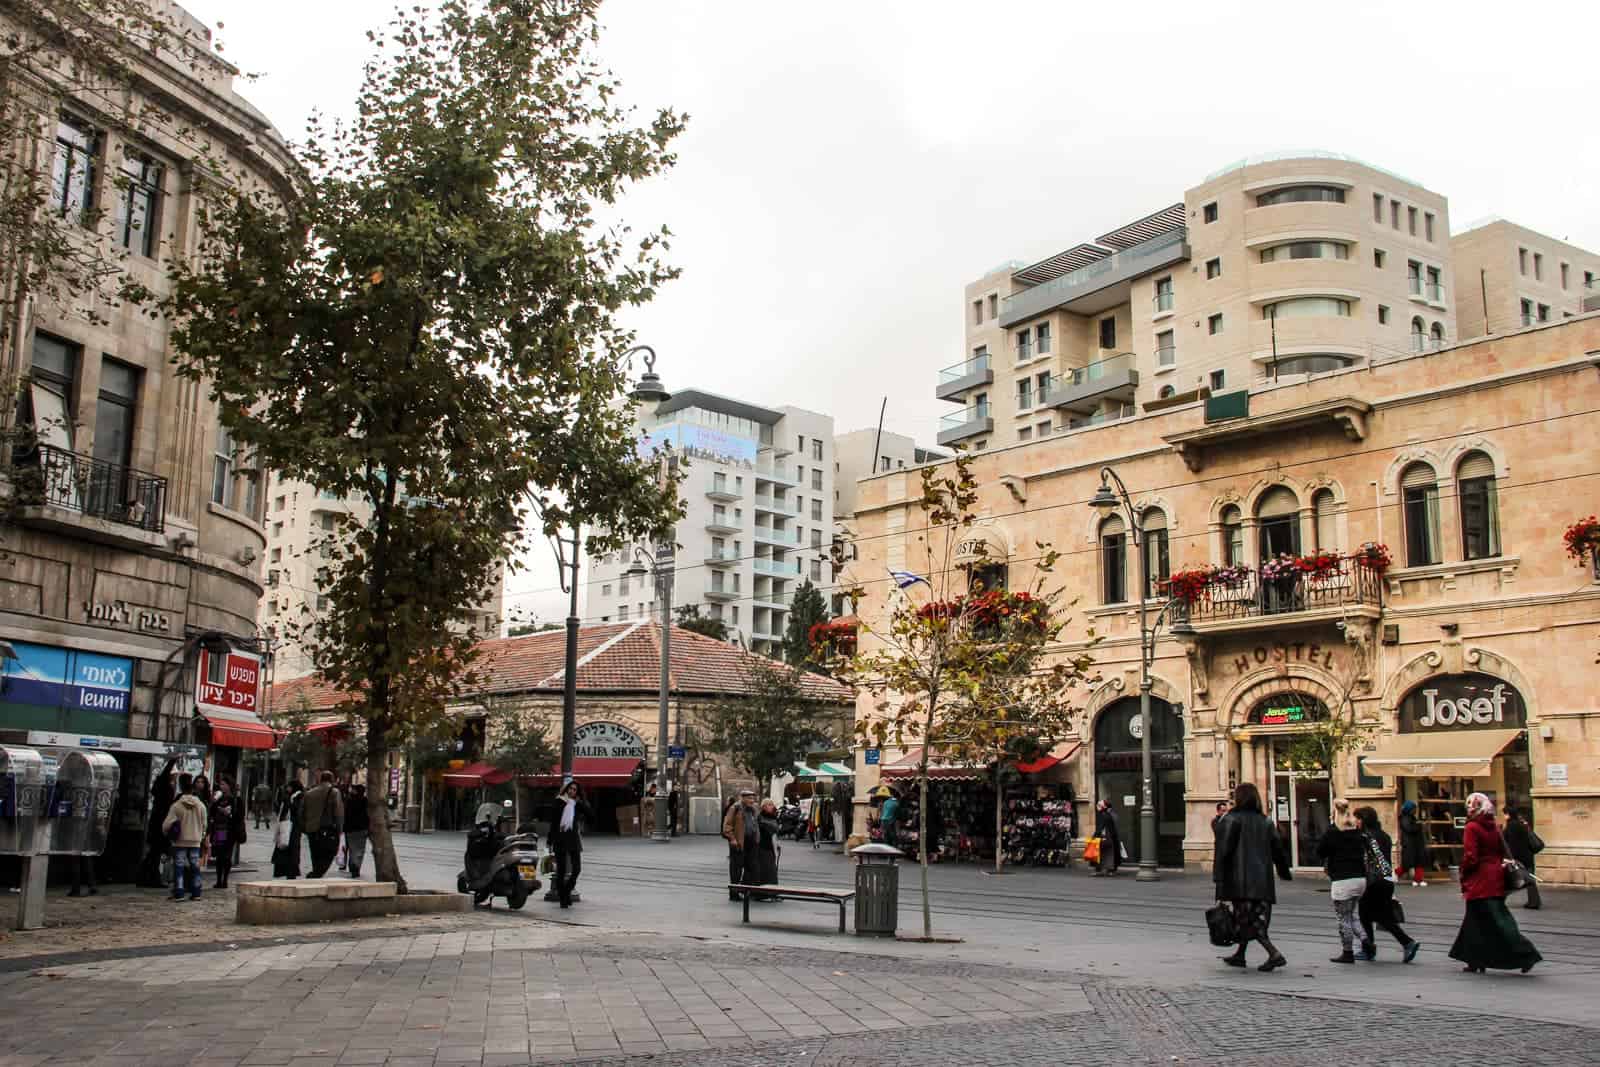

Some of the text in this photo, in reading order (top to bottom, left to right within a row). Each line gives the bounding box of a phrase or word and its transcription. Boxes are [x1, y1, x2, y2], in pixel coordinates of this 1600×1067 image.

[83, 600, 170, 631] בנק לאומי
[1234, 642, 1333, 674] HOSTEL
[81, 664, 127, 685] לאומי
[230, 665, 256, 684] מפגש
[79, 687, 125, 710] leumi
[199, 684, 255, 707] כיכר ציון
[1419, 683, 1507, 727] Josef
[610, 726, 635, 745] נעלי
[611, 745, 645, 758] SHOES
